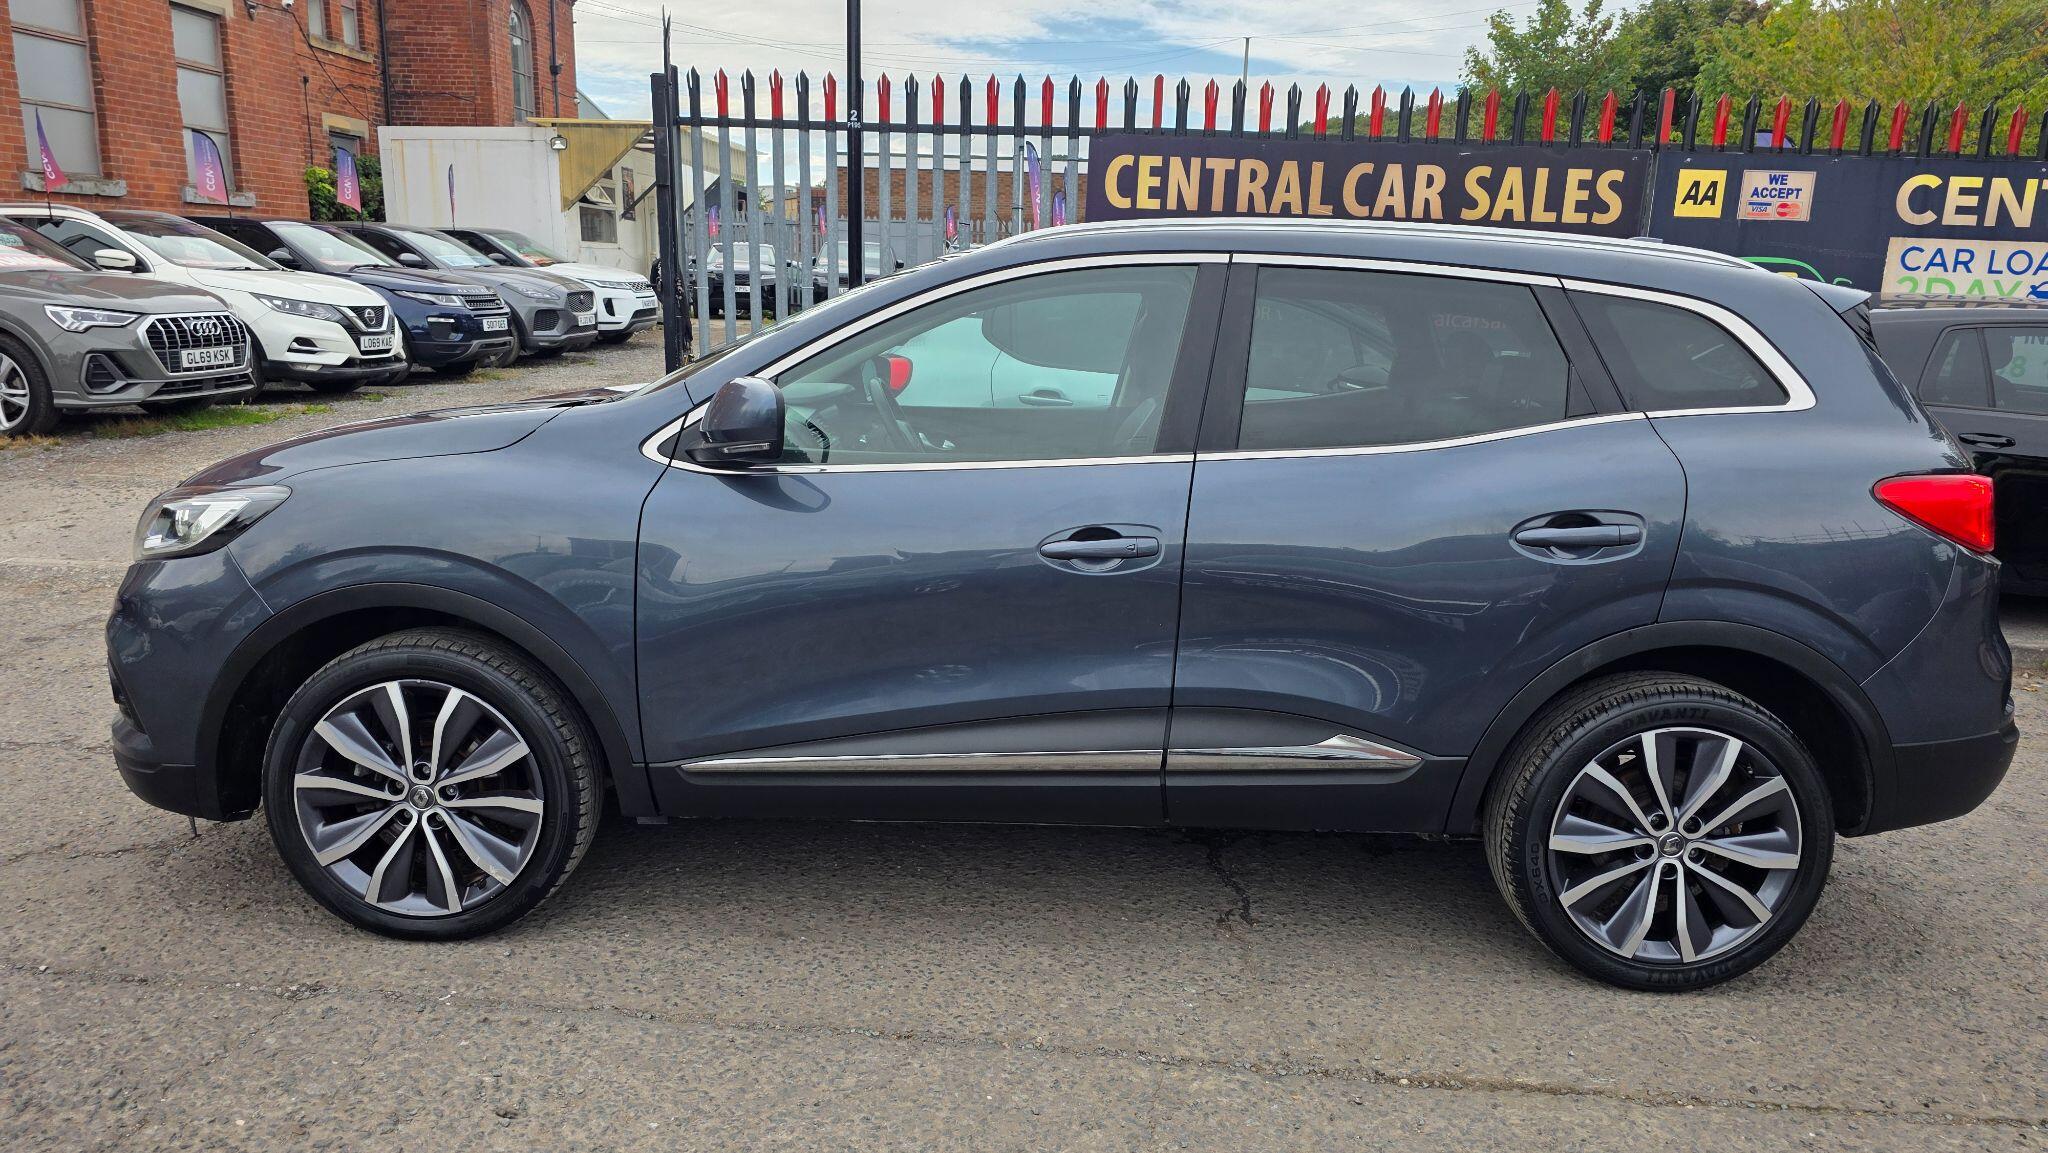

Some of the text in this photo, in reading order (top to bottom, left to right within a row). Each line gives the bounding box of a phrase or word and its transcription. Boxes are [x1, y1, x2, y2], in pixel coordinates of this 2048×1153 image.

[850, 109, 858, 121] 2
[1768, 173, 1788, 186] WE
[1104, 154, 1334, 216] CENTRAL
[1342, 162, 1447, 220] CAR
[1460, 165, 1625, 225] SALES
[1680, 180, 1719, 206] AA
[1750, 187, 1803, 200] ACCEPT
[1900, 245, 1975, 274] CAR
[186, 349, 231, 365] GL69 KSK
